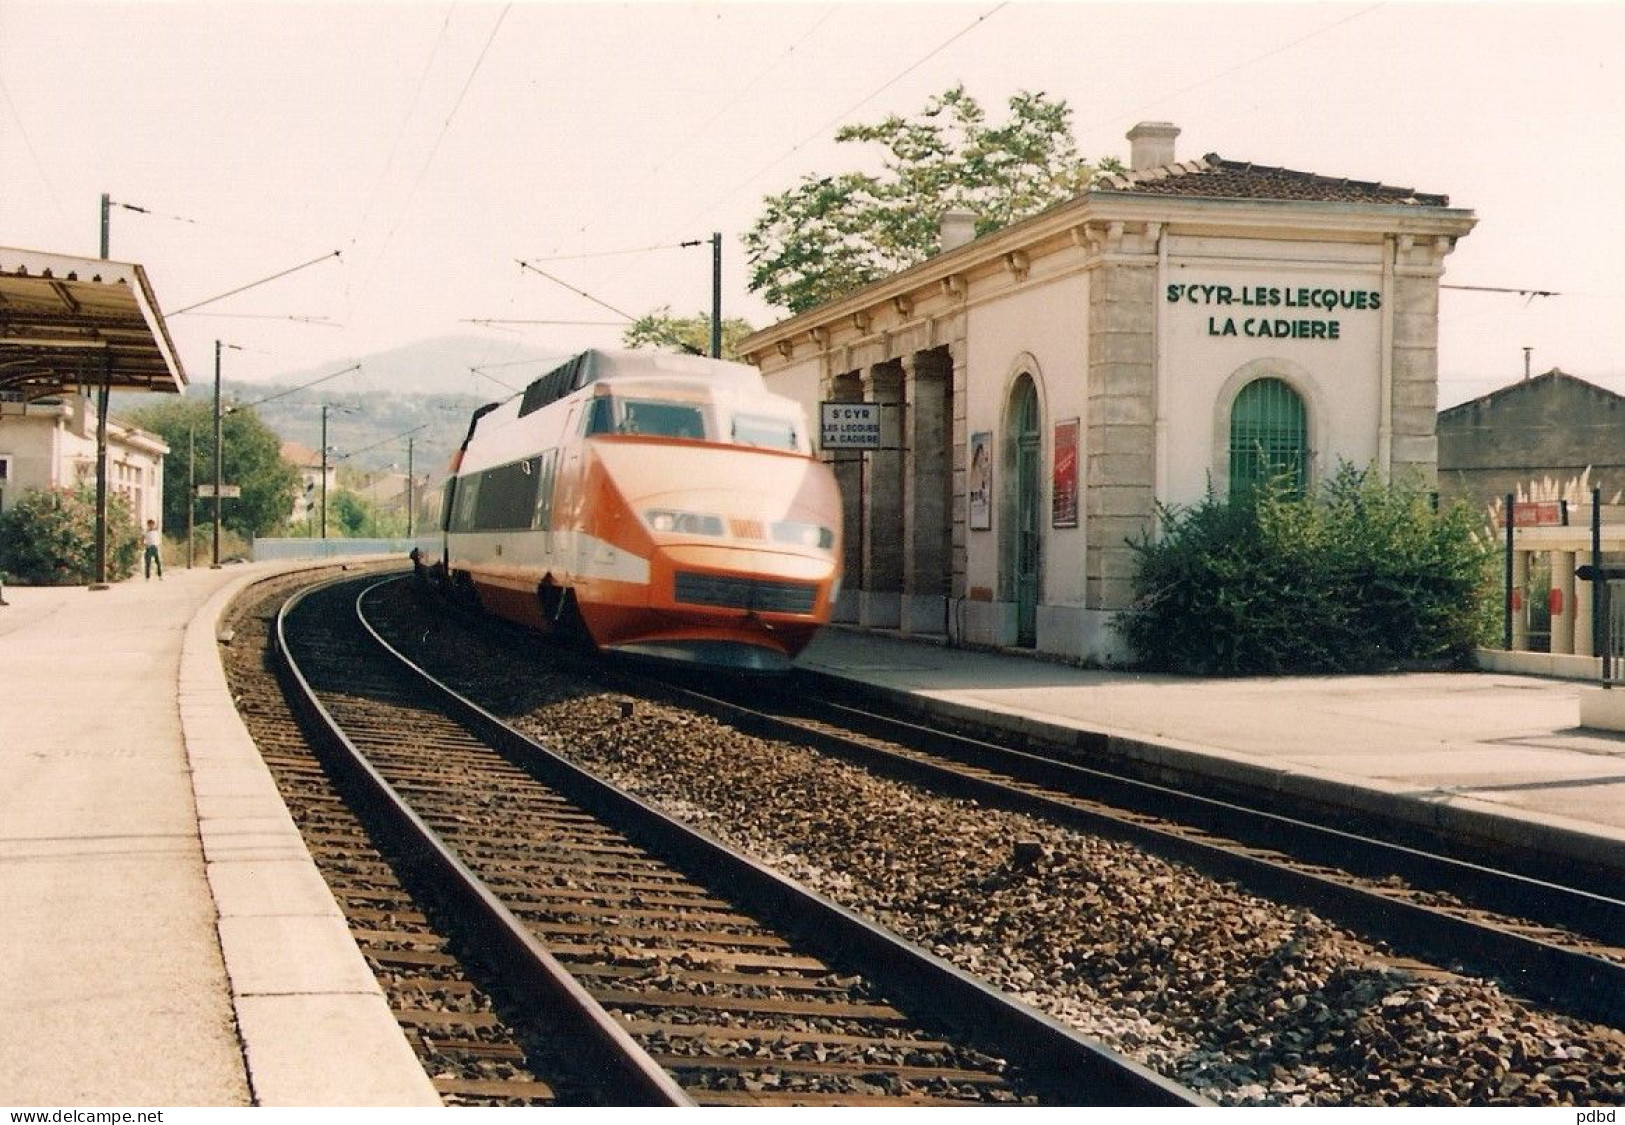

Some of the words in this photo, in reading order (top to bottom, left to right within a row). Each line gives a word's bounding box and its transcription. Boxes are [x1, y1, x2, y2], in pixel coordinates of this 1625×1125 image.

[1285, 288, 1381, 311] LECQUES
[1208, 317, 1238, 336] LA
[1244, 318, 1340, 339] CADIERE
[844, 409, 870, 418] CYR
